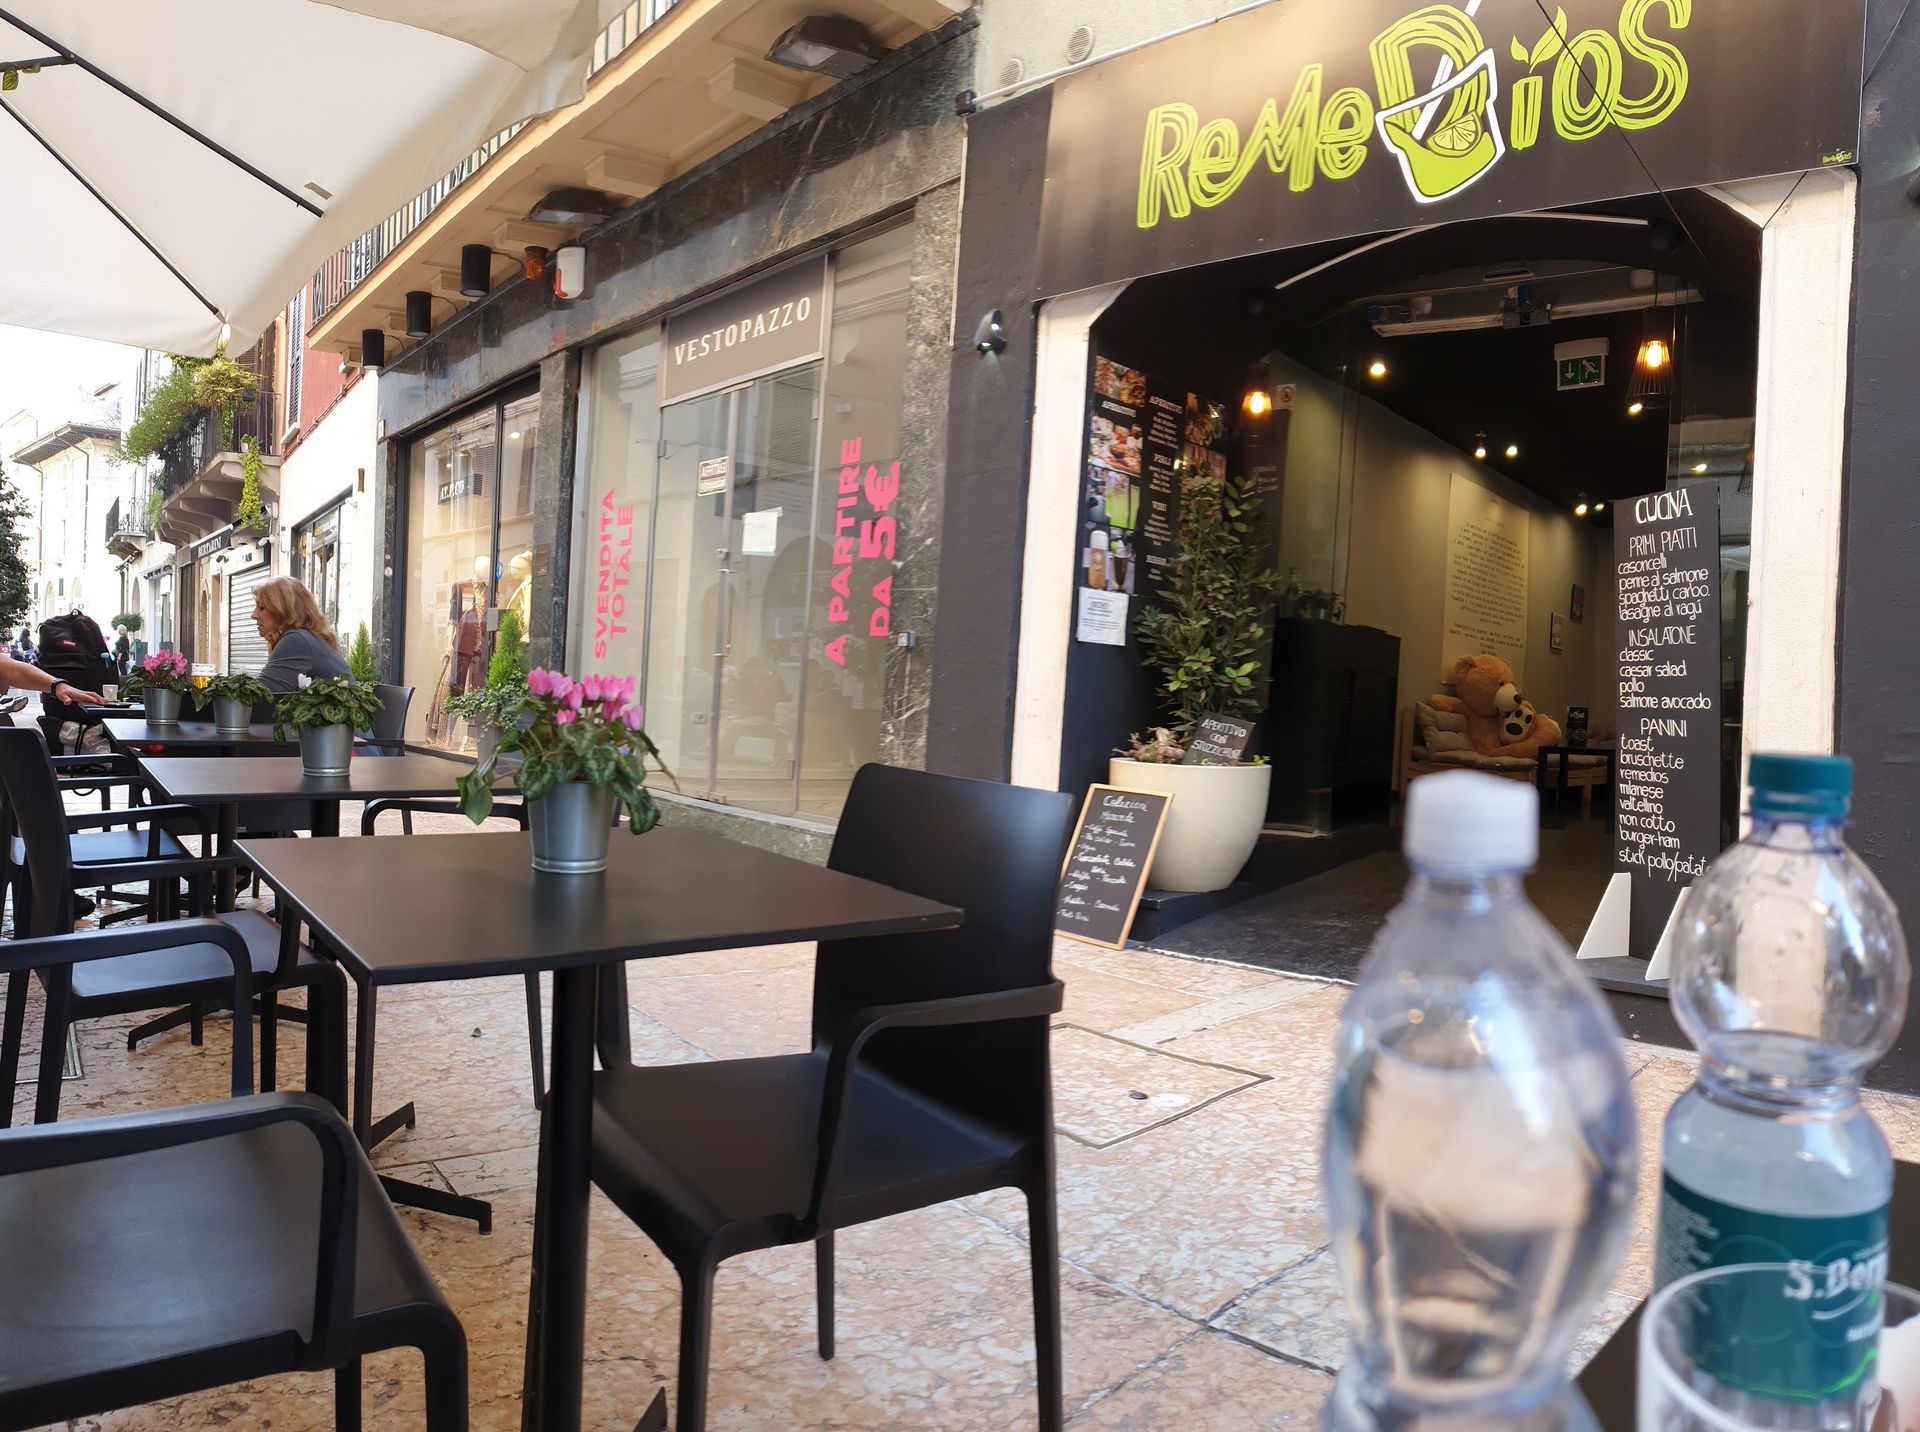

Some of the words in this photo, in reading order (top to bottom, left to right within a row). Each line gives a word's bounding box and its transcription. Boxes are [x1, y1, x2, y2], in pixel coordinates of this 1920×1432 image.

[674, 296, 812, 366] VESTOPAZZO
[858, 459, 900, 561] 5€
[828, 435, 863, 623] PARTIRE
[1629, 533, 1656, 558] PRIMI
[1660, 526, 1697, 553] PIATTI
[593, 487, 617, 661] SVENDITA
[609, 504, 634, 641] TOTALE
[1617, 552, 1668, 574] casoncelli
[1619, 574, 1650, 593] penne
[1650, 570, 1661, 587] al
[1662, 568, 1709, 586] salmone
[1618, 585, 1669, 608] spaghetti
[1672, 583, 1711, 599] carbo.
[869, 576, 894, 638] DA
[1618, 604, 1661, 623] lasagne
[1663, 600, 1674, 616] al
[1628, 625, 1697, 647] INSALATONE
[824, 634, 848, 667] A
[1619, 647, 1655, 662] classic
[1619, 665, 1652, 677] caesar
[1655, 660, 1688, 677] salad
[1619, 677, 1645, 696] pollo
[1619, 695, 1659, 709] salmone
[1661, 692, 1712, 710] avocado
[1640, 718, 1688, 738] PANINI
[1620, 733, 1655, 752] toast
[1619, 749, 1685, 770] bruschette
[1619, 767, 1669, 784] remedios
[1618, 781, 1664, 799] milanese
[1618, 796, 1664, 814] valtellino
[1618, 813, 1638, 827] non
[1640, 814, 1676, 833] cotto
[1618, 825, 1681, 850] burger-ham
[1618, 847, 1646, 865] stick
